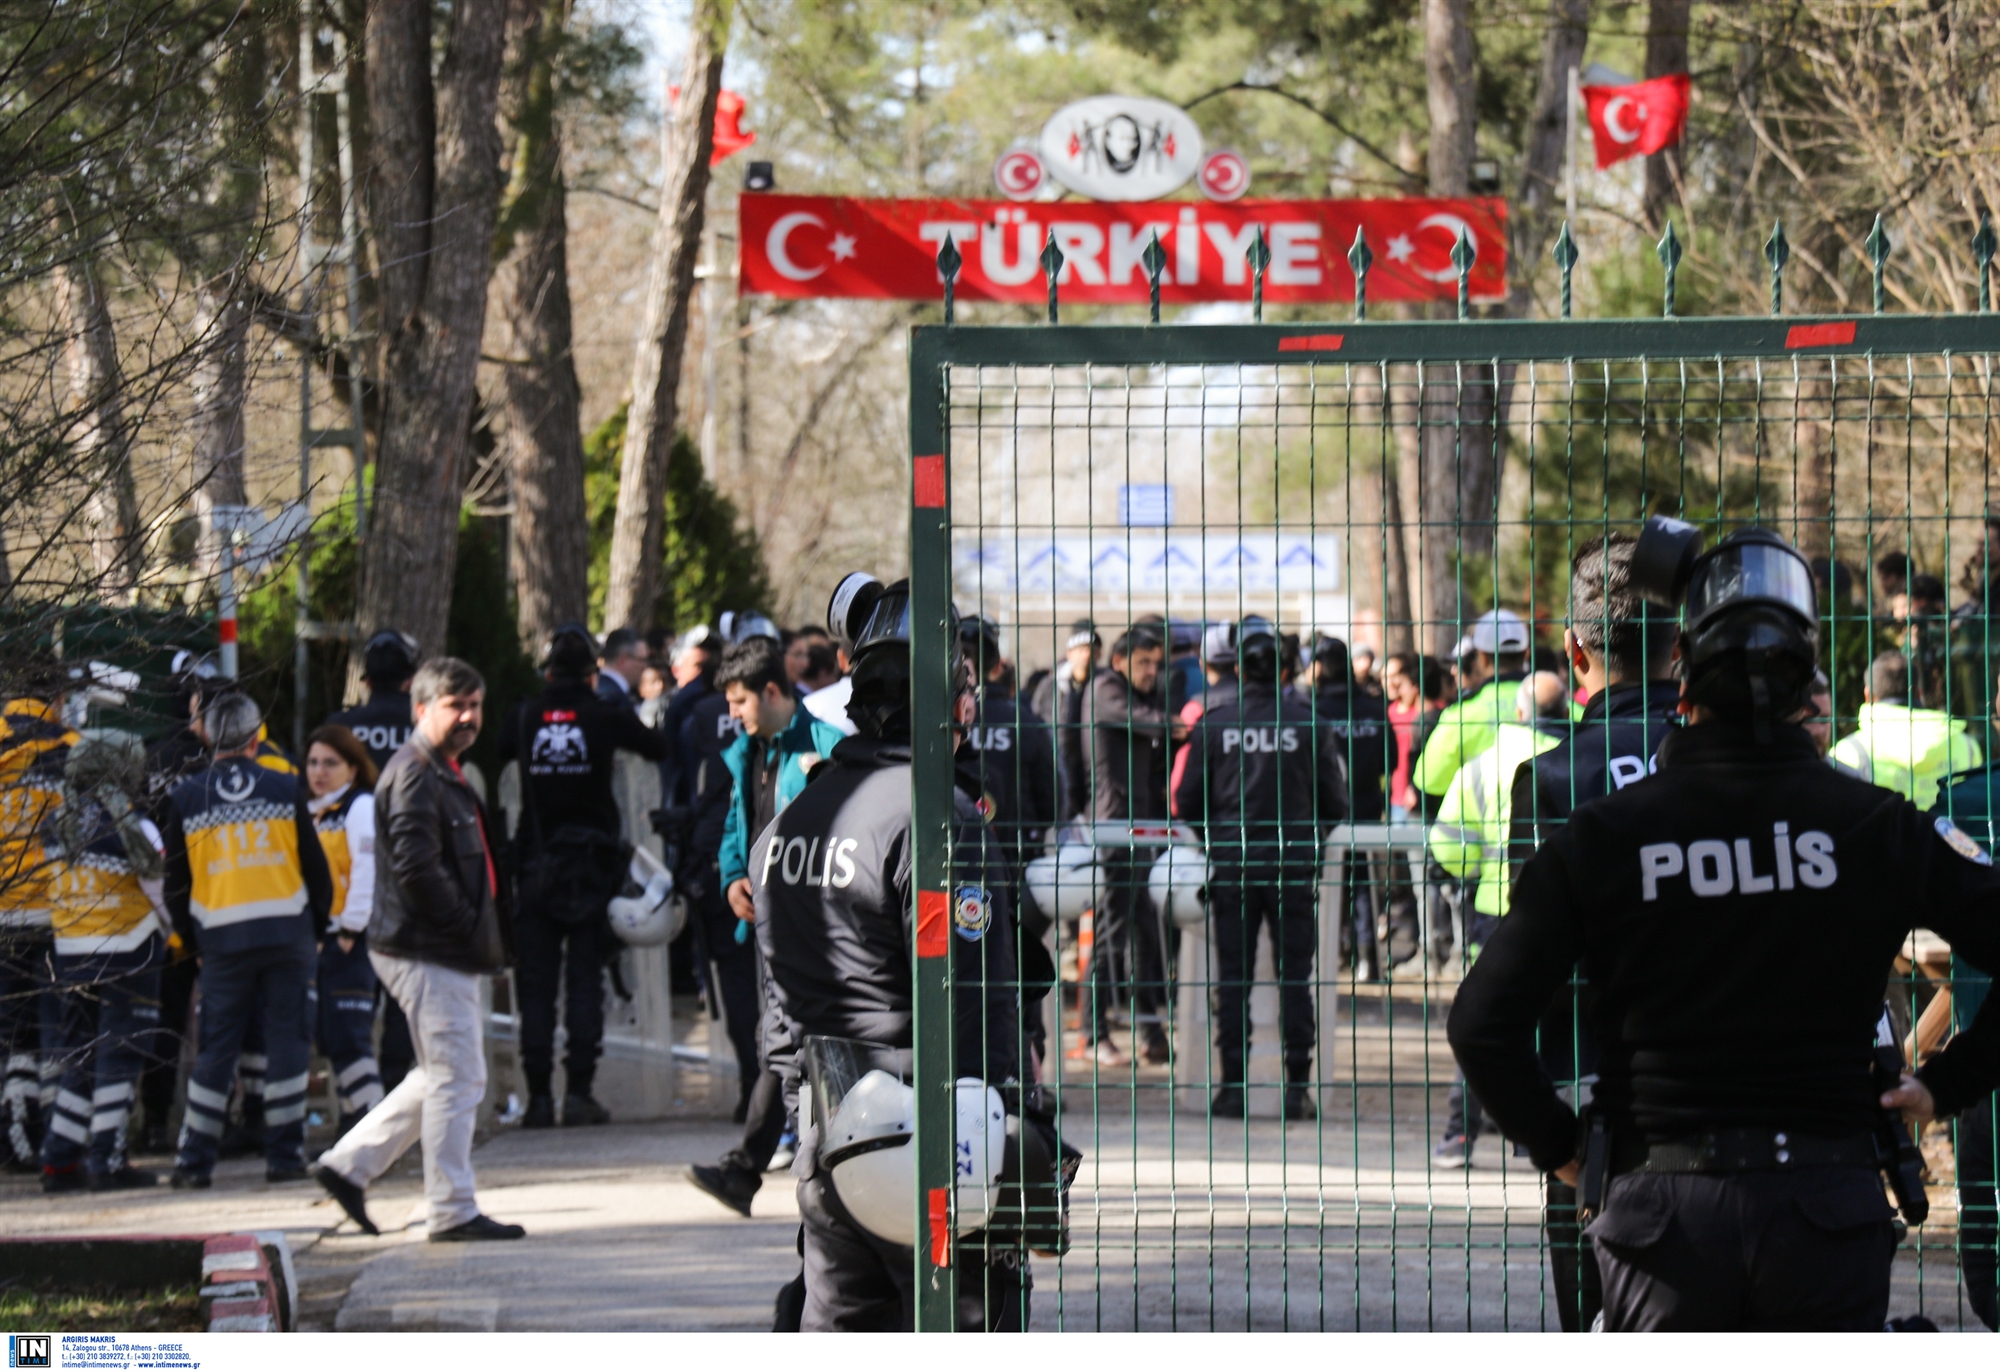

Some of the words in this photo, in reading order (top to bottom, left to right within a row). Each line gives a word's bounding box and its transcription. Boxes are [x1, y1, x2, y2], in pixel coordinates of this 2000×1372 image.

[919, 207, 1322, 286] TÜRKİYE
[216, 820, 270, 852] 112
[760, 835, 858, 889] POLİS
[1639, 821, 1838, 902] POLİS
